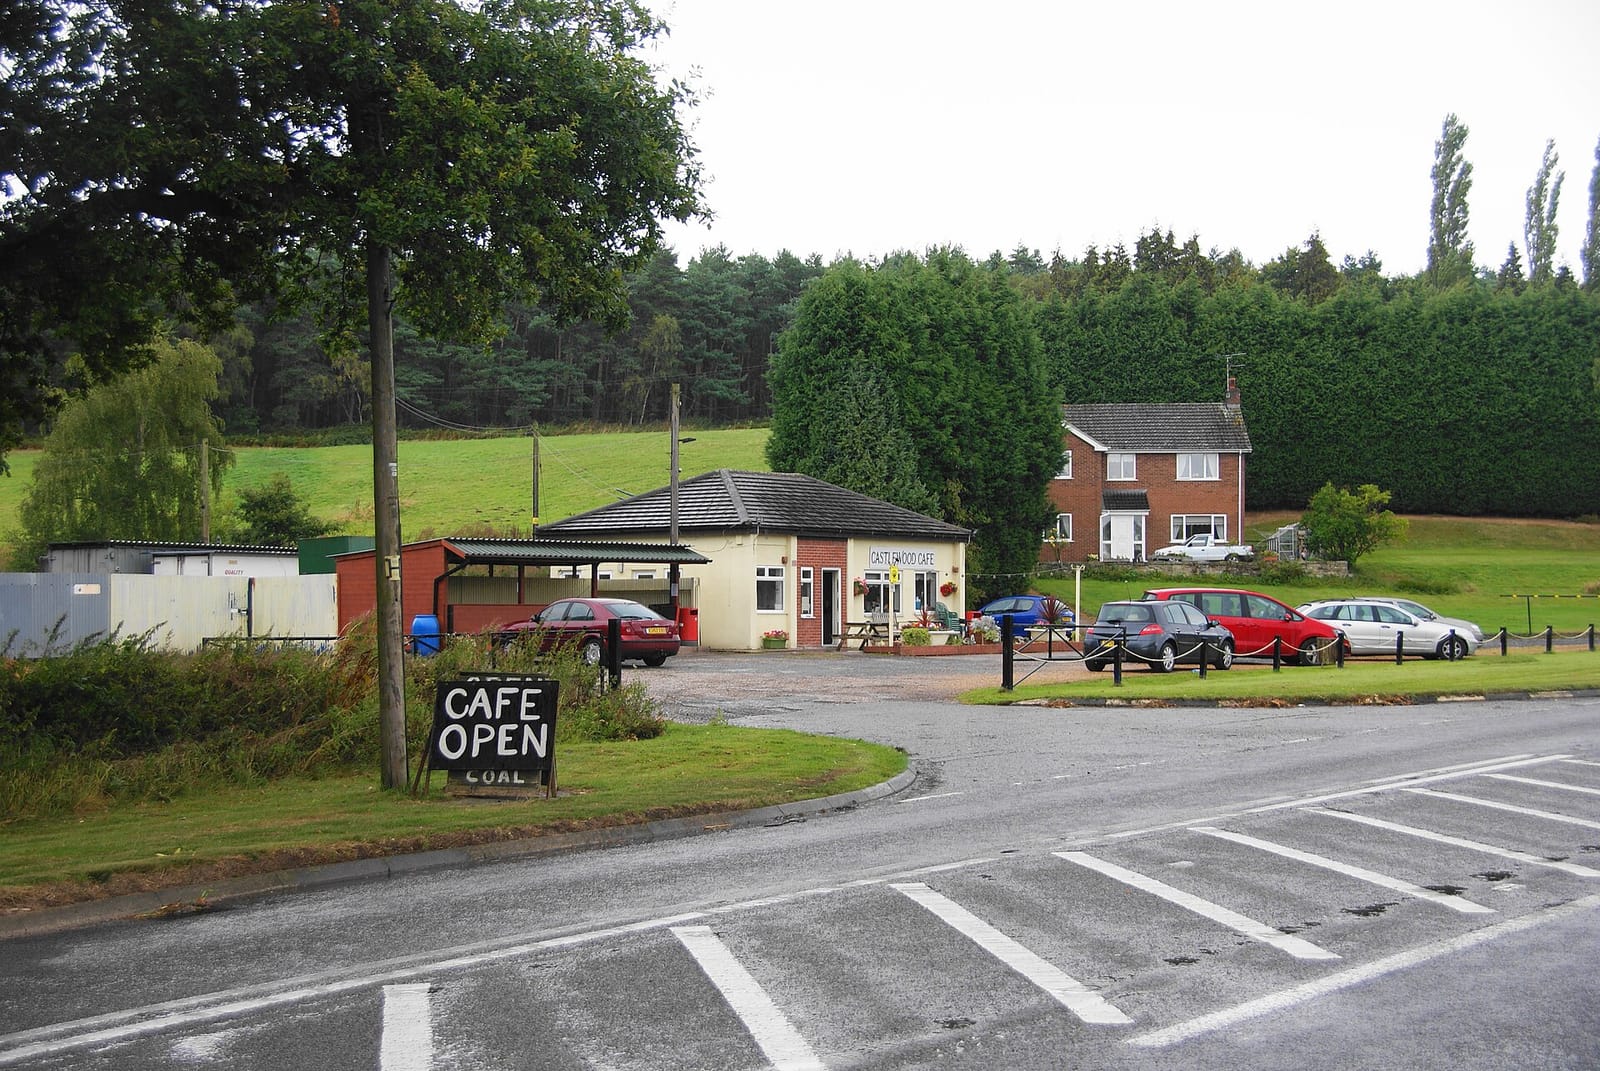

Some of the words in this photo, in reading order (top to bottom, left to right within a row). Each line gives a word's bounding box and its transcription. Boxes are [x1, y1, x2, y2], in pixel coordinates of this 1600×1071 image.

[872, 551, 916, 564] CASTLEWOOD
[918, 552, 935, 566] CAFE
[445, 687, 542, 720] CAFE
[438, 724, 548, 760] OPEN
[466, 770, 525, 784] COAL
